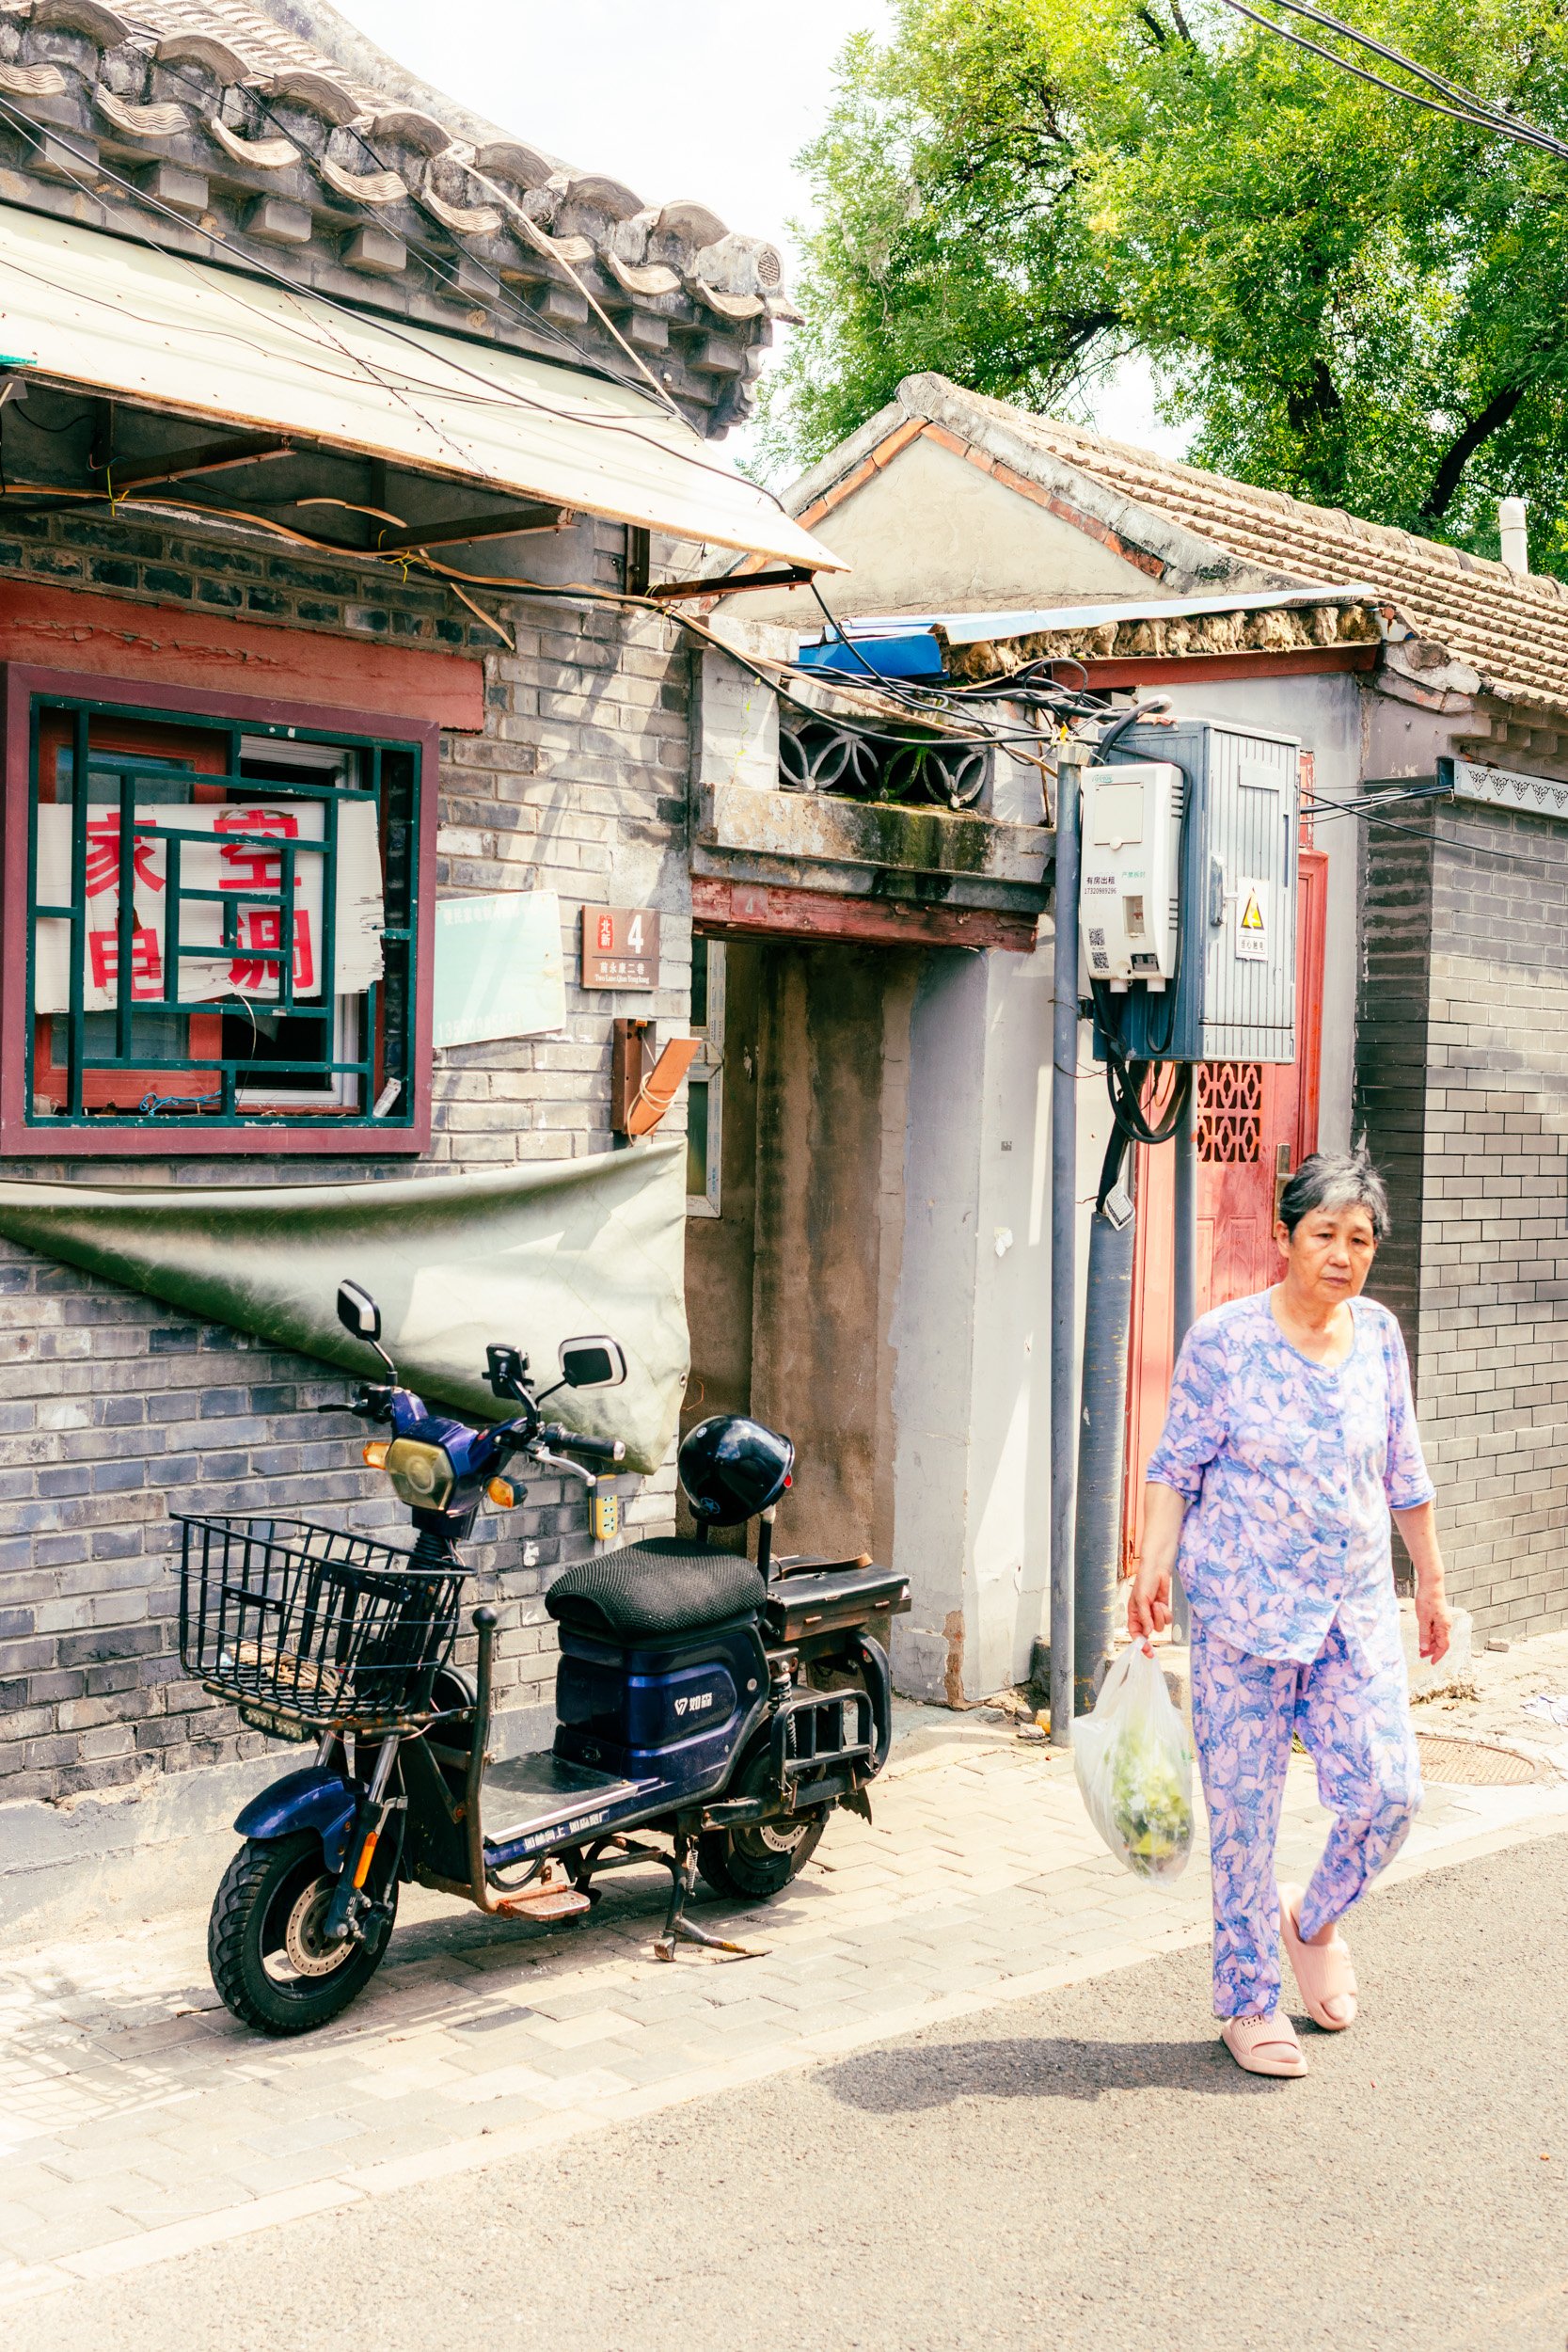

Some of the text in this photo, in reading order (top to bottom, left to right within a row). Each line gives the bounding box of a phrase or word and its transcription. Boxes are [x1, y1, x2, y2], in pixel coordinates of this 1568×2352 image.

[1086, 876, 1116, 885] 有房出租
[627, 914, 643, 953] 4
